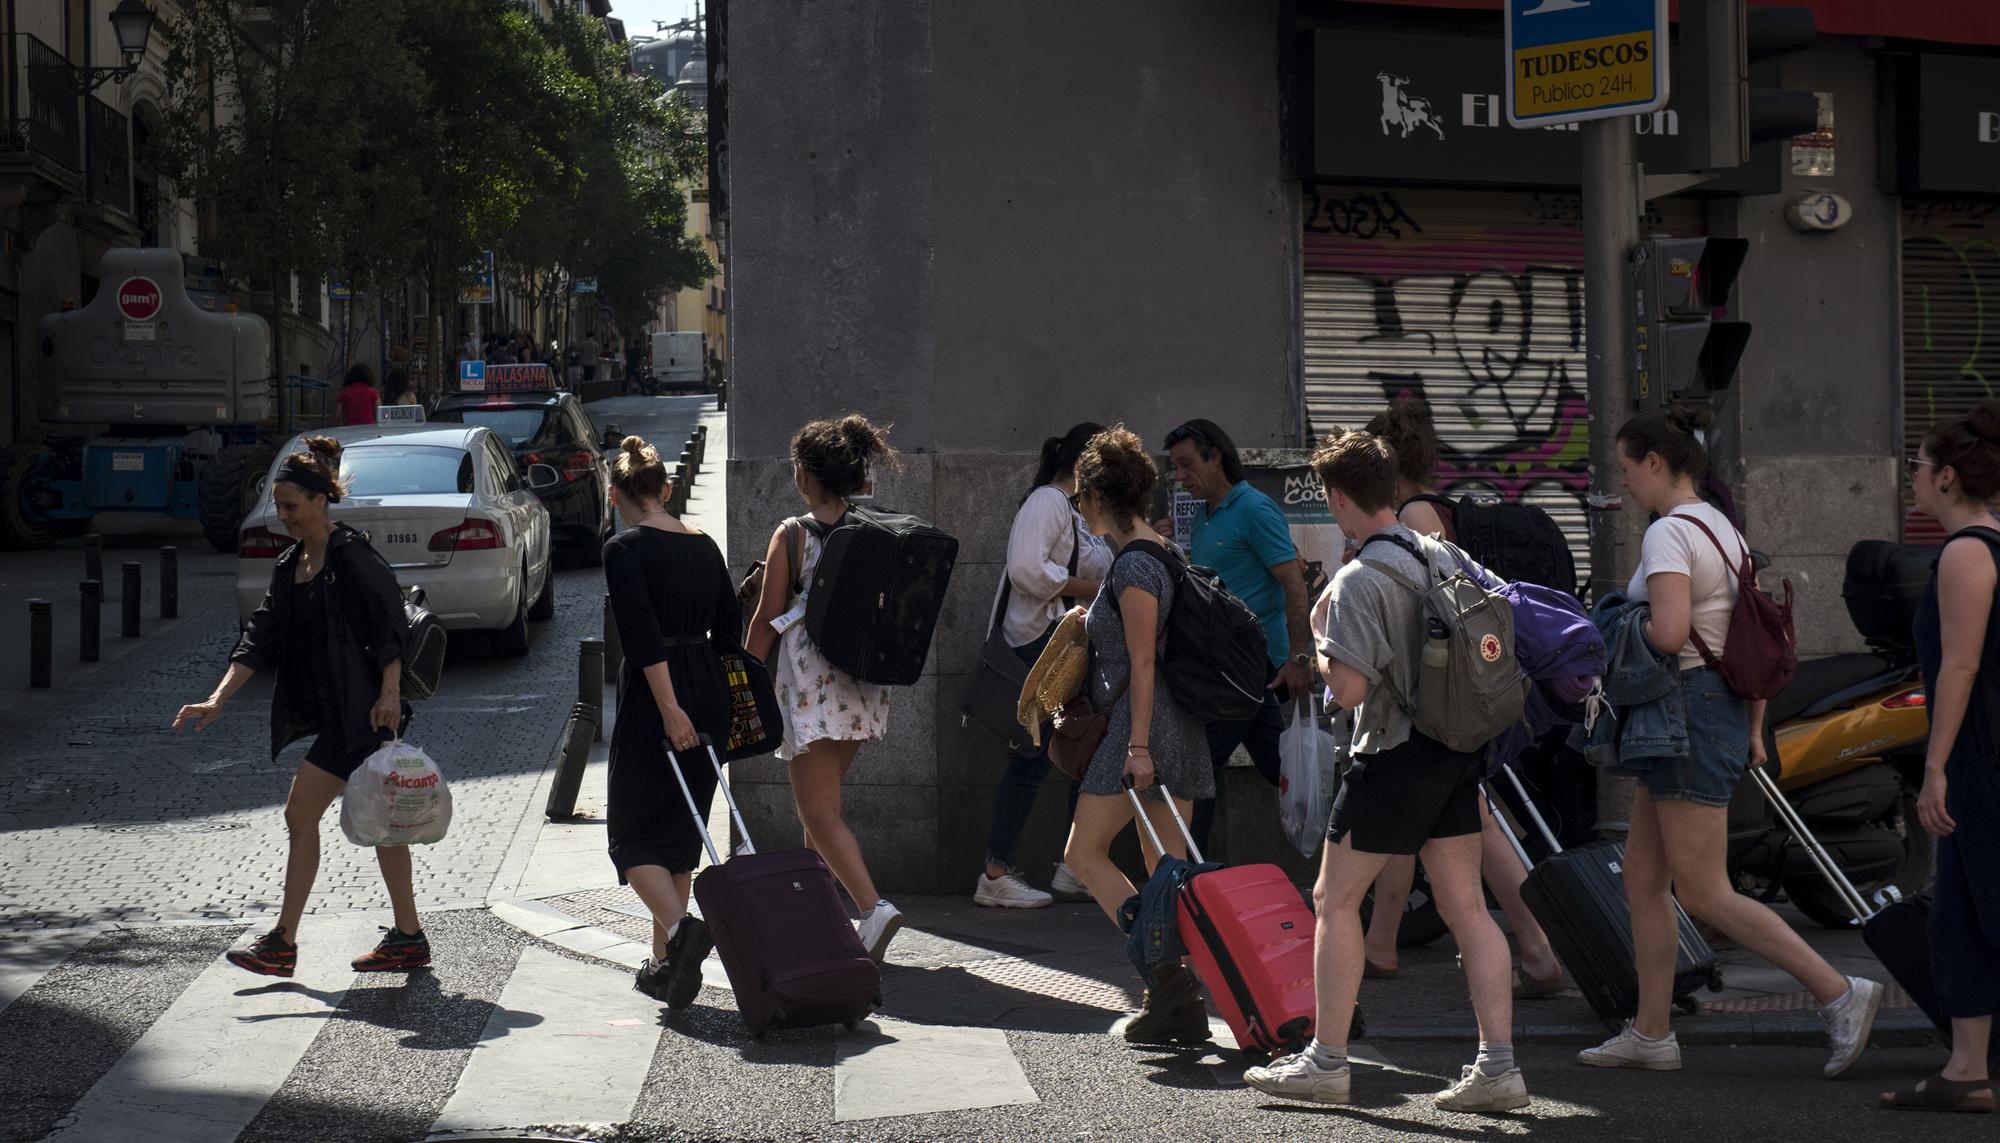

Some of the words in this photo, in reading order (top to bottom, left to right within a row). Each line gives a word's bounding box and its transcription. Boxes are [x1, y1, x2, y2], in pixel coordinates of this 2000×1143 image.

[1519, 40, 1649, 79] TUDESCOS
[1532, 80, 1595, 104] Publico
[1461, 92, 1499, 128] El
[466, 363, 478, 377] L
[391, 409, 414, 420] TAXI
[1283, 488, 1326, 505] COO
[387, 533, 417, 543] 01963
